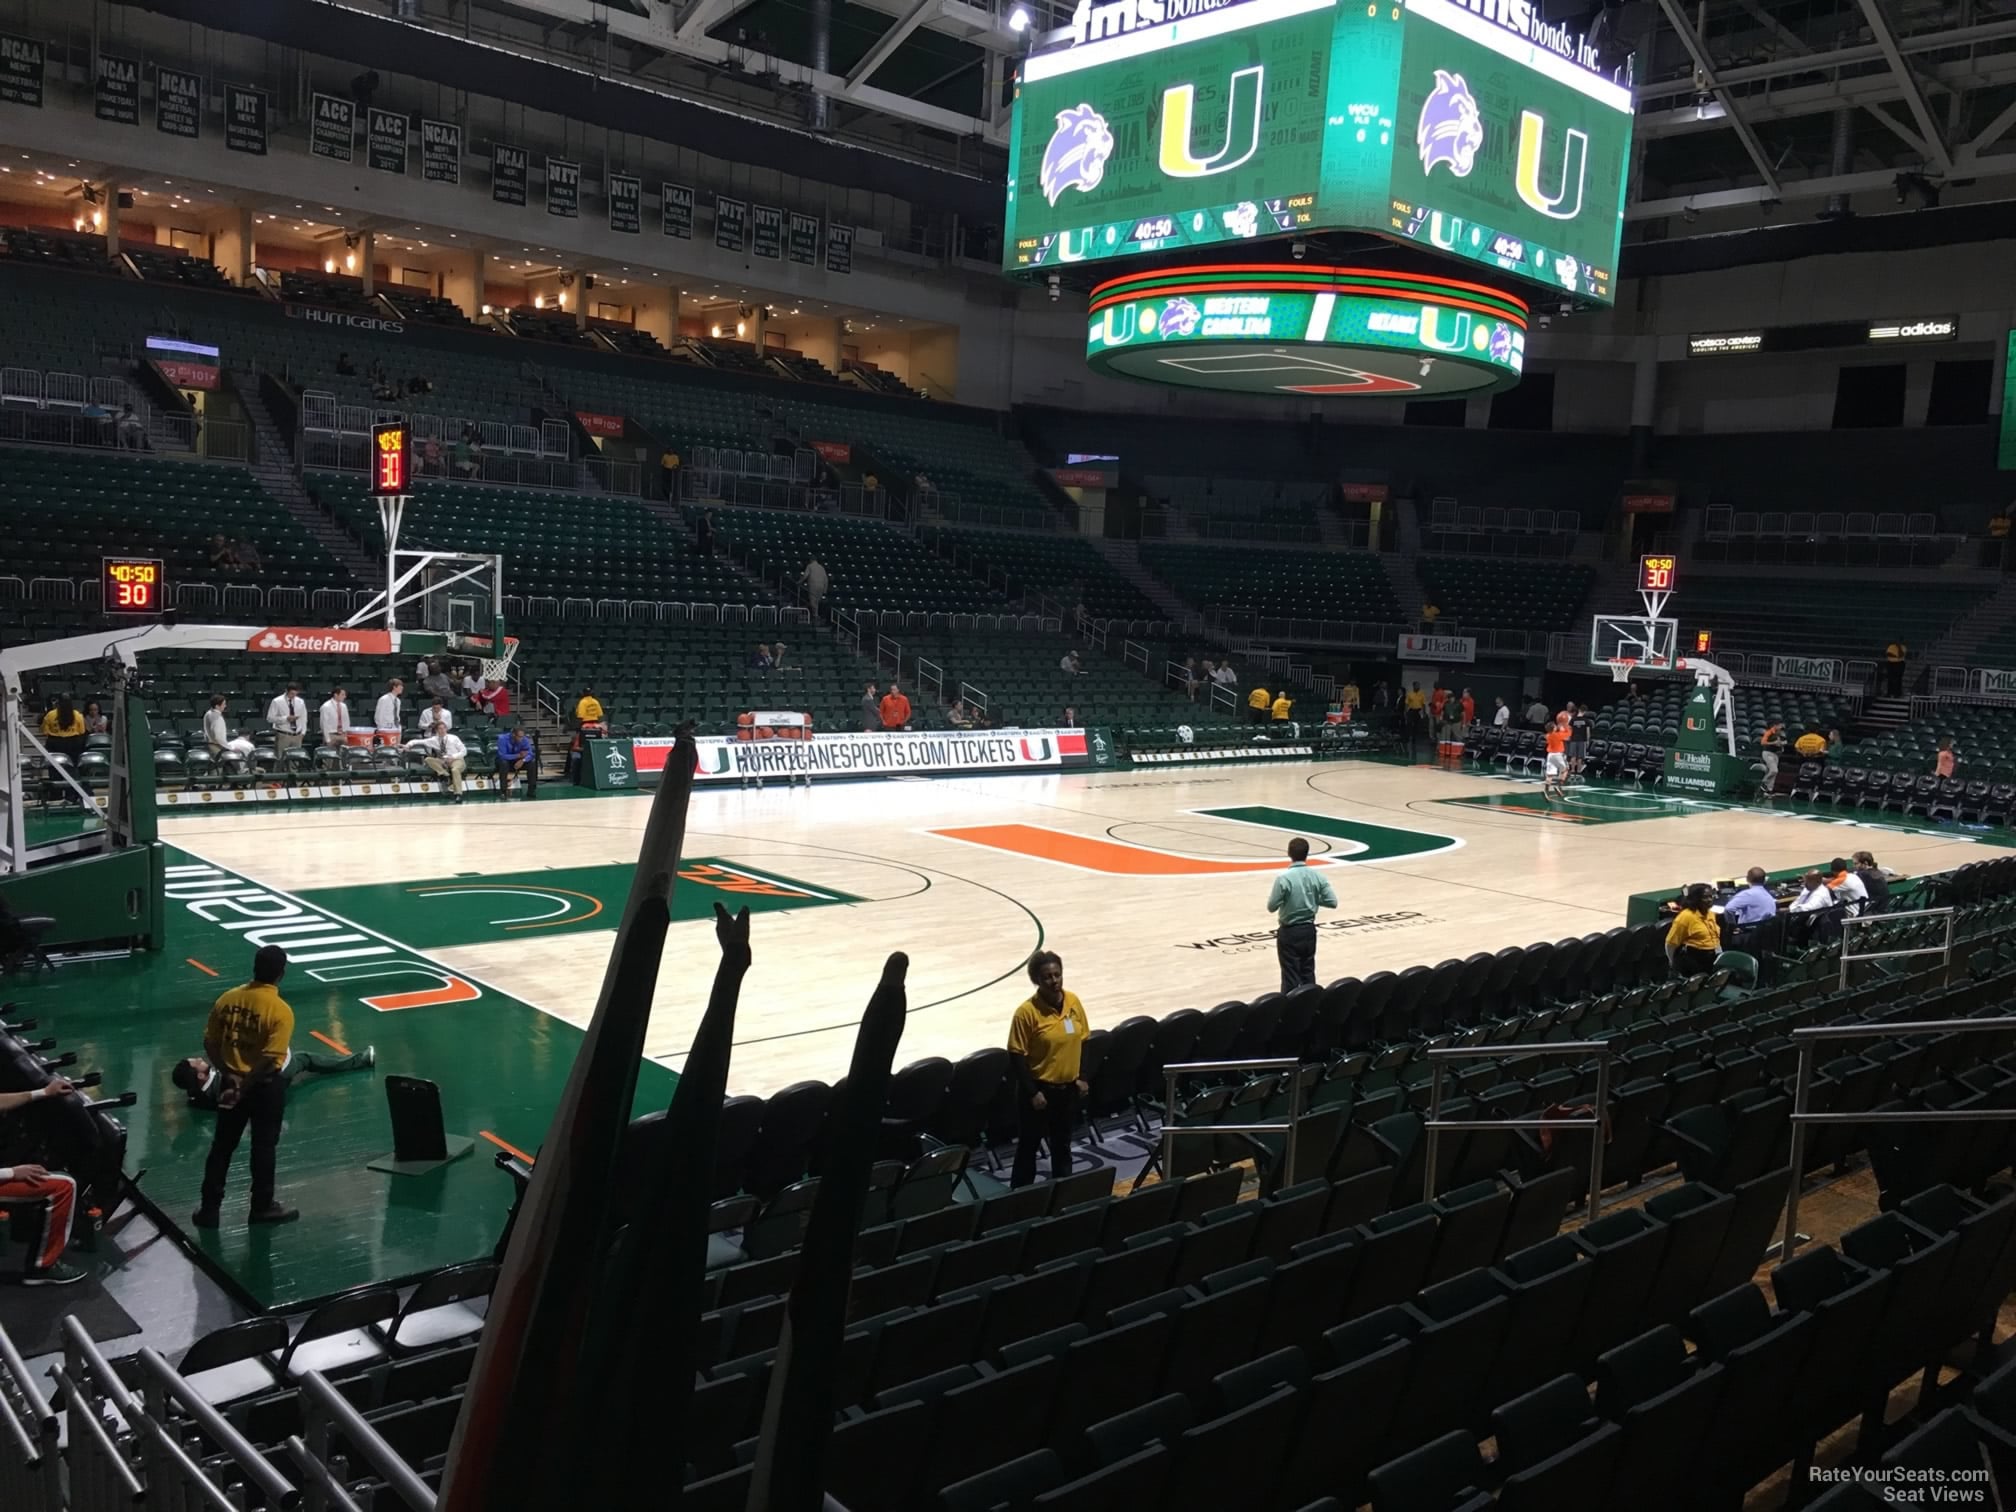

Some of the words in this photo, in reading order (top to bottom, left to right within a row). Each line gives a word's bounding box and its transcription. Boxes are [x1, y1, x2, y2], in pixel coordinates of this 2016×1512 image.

[1530, 7, 1575, 59] bonds,
[1577, 34, 1601, 73] Inc.
[1, 38, 40, 64] NCAA
[98, 58, 136, 82] NCAA
[160, 72, 197, 98] NCAA
[235, 92, 257, 114] NIT
[320, 100, 348, 122] ACC
[314, 119, 351, 134] CONFERENCE
[375, 115, 401, 135] ACC
[316, 128, 349, 142] CHAMPIONS
[370, 134, 404, 148] CONFERENCE
[425, 125, 457, 146] NCAA
[372, 142, 403, 156] CHAMPIONS
[496, 147, 525, 169] NCAA
[549, 164, 577, 185] NIT
[611, 179, 638, 199] NIT
[665, 187, 691, 207] NCAA
[719, 200, 744, 220] NIT
[1273, 200, 1280, 211] 2
[1289, 197, 1313, 207] FOULS
[1392, 201, 1412, 214] FOULS
[756, 209, 780, 227] NIT
[792, 217, 816, 234] NIT
[1192, 212, 1204, 231] 0
[1282, 216, 1289, 227] 4
[1297, 214, 1311, 223] TOL
[829, 228, 850, 244] NIT
[1106, 226, 1116, 245] 0
[1134, 219, 1172, 240] 40:50
[1407, 223, 1413, 234] 4
[1471, 226, 1480, 247] 0
[1018, 239, 1037, 249] FOULS
[1494, 236, 1523, 260] 40:50
[1034, 251, 1041, 262] 4
[1590, 282, 1595, 293] 4
[1203, 297, 1271, 315] WESTERN
[1201, 317, 1272, 335] CAROLINA
[1901, 322, 1951, 336] adidas
[379, 431, 401, 450] 40:50
[382, 453, 400, 487] 30
[1645, 558, 1672, 569] 40:50
[110, 565, 154, 583] 40:50
[1647, 569, 1668, 587] 30
[118, 583, 147, 605] 30
[1777, 658, 1832, 677] MILAMS
[734, 738, 1015, 774] HURRICANESPORTS.COM/TICKETS
[1666, 775, 1716, 788] WILLIAMSON
[221, 1004, 260, 1023] APEX
